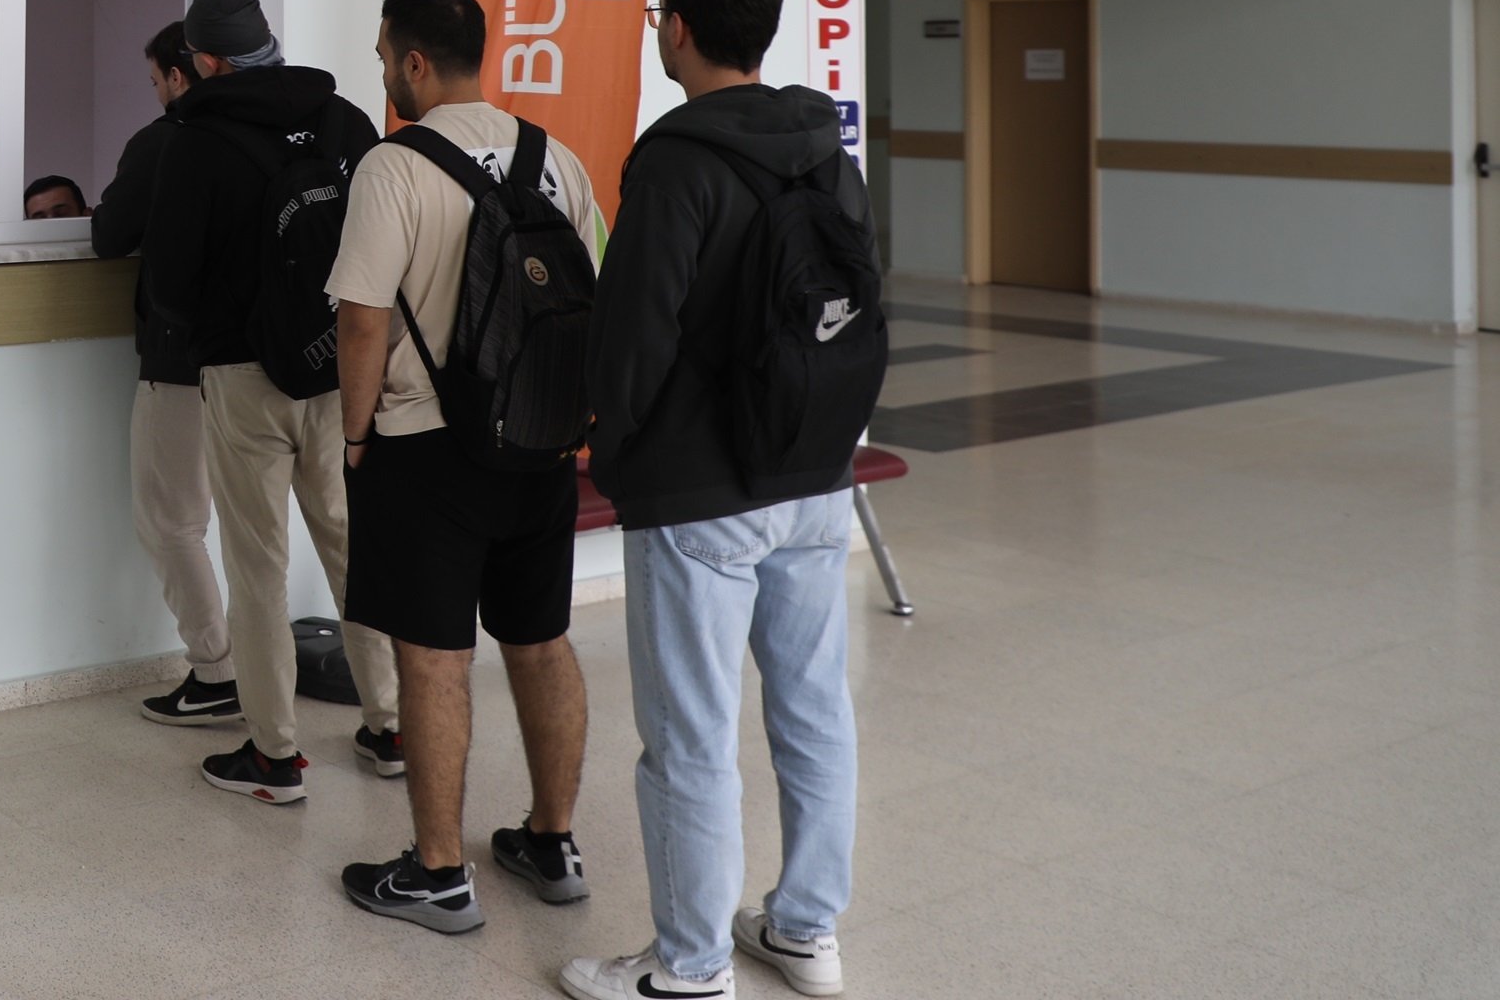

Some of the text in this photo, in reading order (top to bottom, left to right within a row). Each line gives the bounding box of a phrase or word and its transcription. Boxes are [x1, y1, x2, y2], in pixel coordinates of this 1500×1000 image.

[302, 185, 338, 205] PUMA
[823, 298, 850, 324] NIKE
[303, 323, 338, 370] PU
